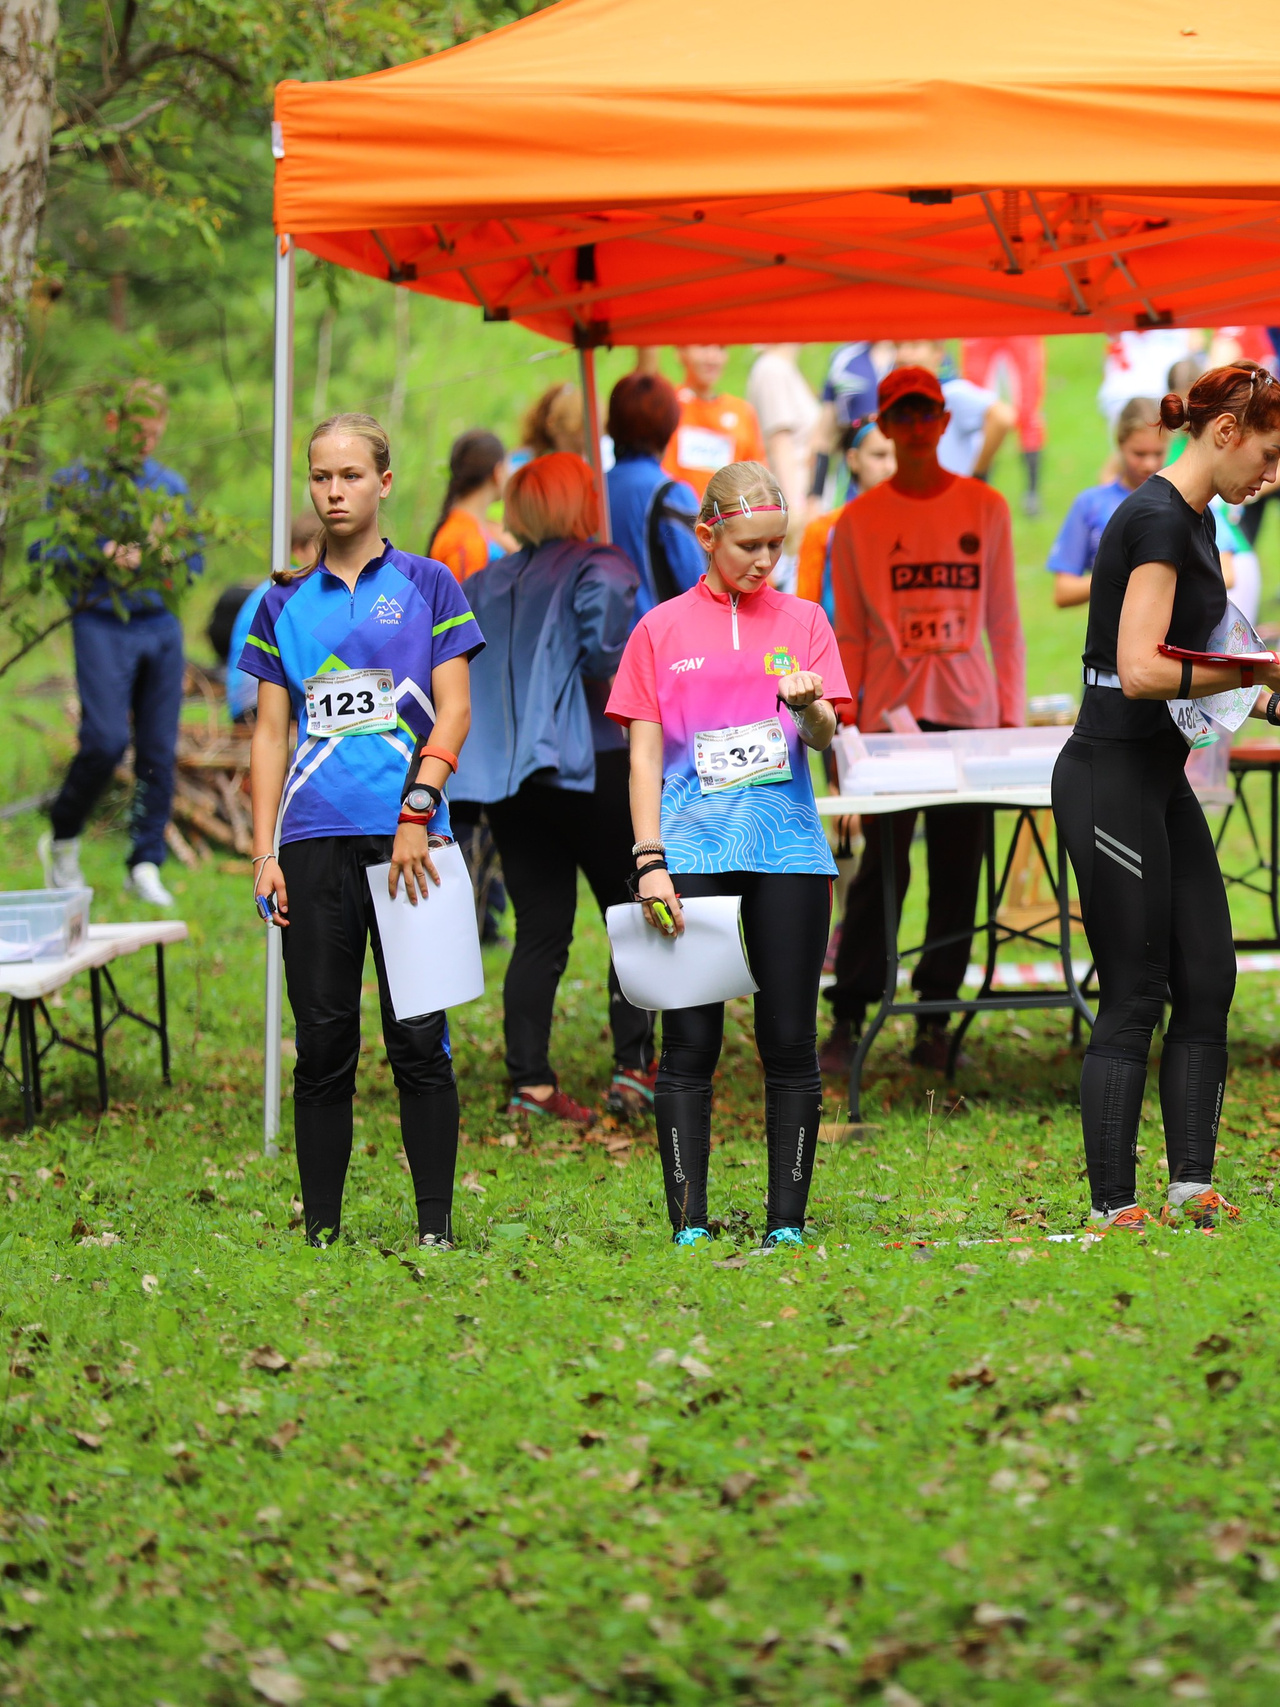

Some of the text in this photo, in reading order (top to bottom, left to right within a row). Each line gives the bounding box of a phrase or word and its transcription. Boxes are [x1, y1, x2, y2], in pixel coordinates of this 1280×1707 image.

[669, 656, 706, 675] RAY
[319, 690, 375, 717] 123
[710, 744, 769, 771] 532
[671, 1127, 683, 1168] NORD
[796, 1126, 806, 1167] NORD
